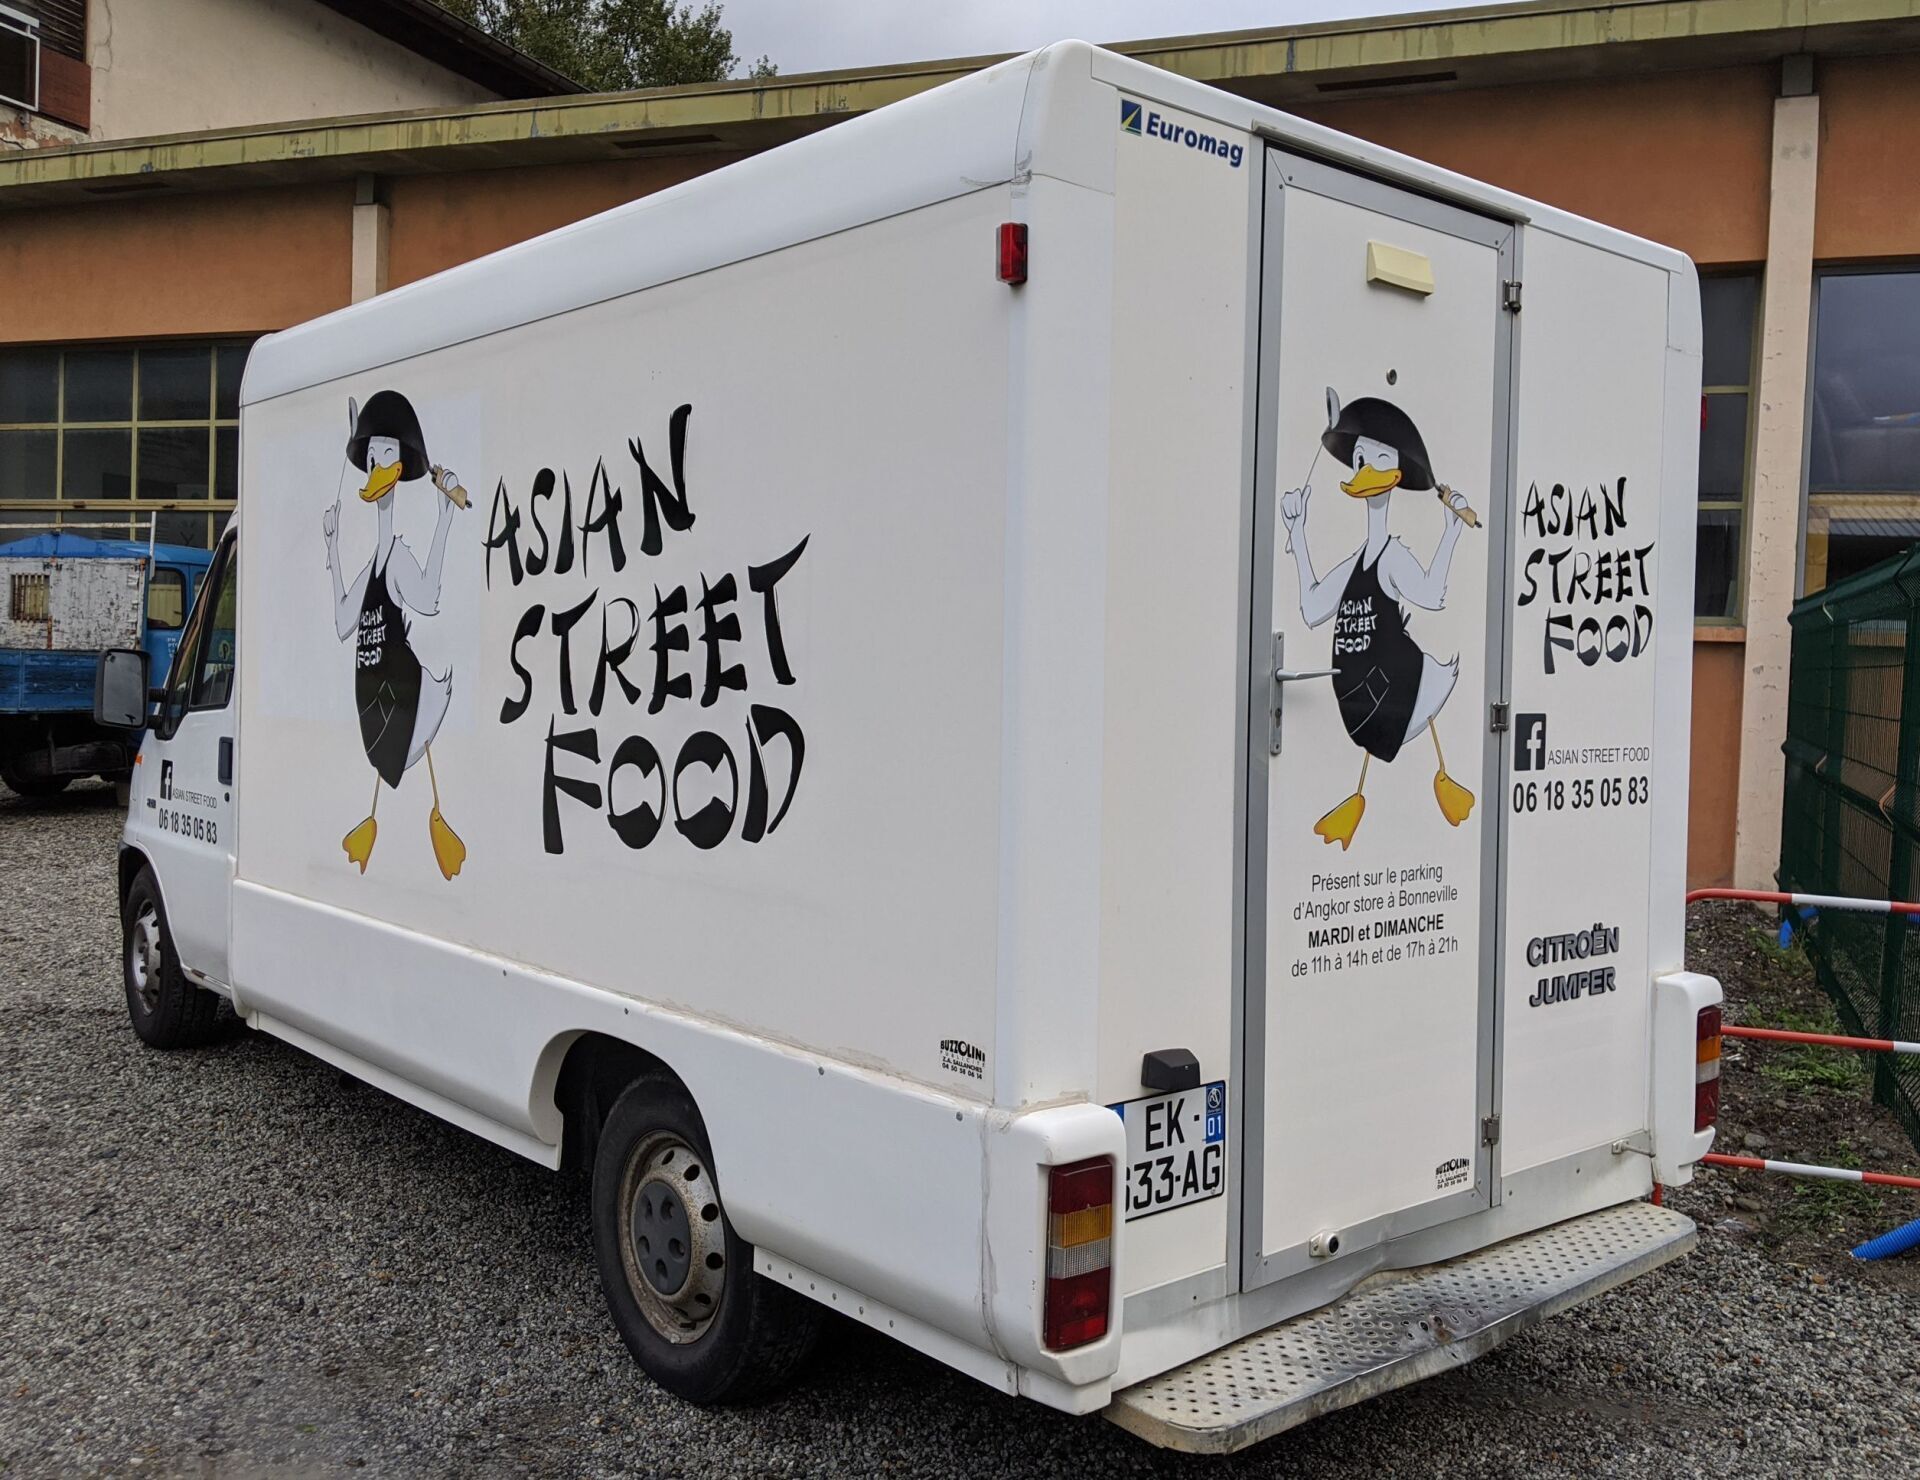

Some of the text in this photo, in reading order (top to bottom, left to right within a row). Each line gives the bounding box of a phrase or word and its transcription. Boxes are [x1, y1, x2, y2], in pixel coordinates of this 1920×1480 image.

[1146, 111, 1244, 168] Euromag
[481, 402, 697, 592] ASIAN
[1520, 476, 1627, 540] ASIAN
[1517, 541, 1655, 606] STREET
[359, 605, 383, 627] ASIAN
[1334, 613, 1378, 634] STREET
[1340, 596, 1373, 616] ASIAN
[356, 624, 387, 647] STREET
[499, 532, 811, 724] STREET
[1334, 634, 1371, 656] FOOD
[1543, 604, 1653, 675] FOOD
[357, 647, 382, 669] FOOD
[1547, 746, 1650, 765] ASIAN STREET FOOD
[543, 703, 806, 855] FOOD
[1513, 775, 1649, 813] 06 18 35 05 83
[172, 788, 217, 809] ASIAN STREET FOOD
[159, 807, 217, 845] 06 18 35 05 83
[1311, 863, 1443, 892] Présent sur le parking
[1354, 896, 1384, 914] store
[1387, 891, 1395, 909] à
[1398, 885, 1458, 907] Bonneville
[1308, 913, 1445, 949] MARDI et DIMANCHE
[1526, 921, 1620, 968] CITROËN
[1291, 936, 1458, 977] de 11h à 14h et de 17h à 21h
[1528, 966, 1617, 1007] JUMPER
[940, 1039, 986, 1062] BUZZOLINI
[1207, 1116, 1222, 1137] 01
[1126, 1144, 1221, 1213] 33-AG
